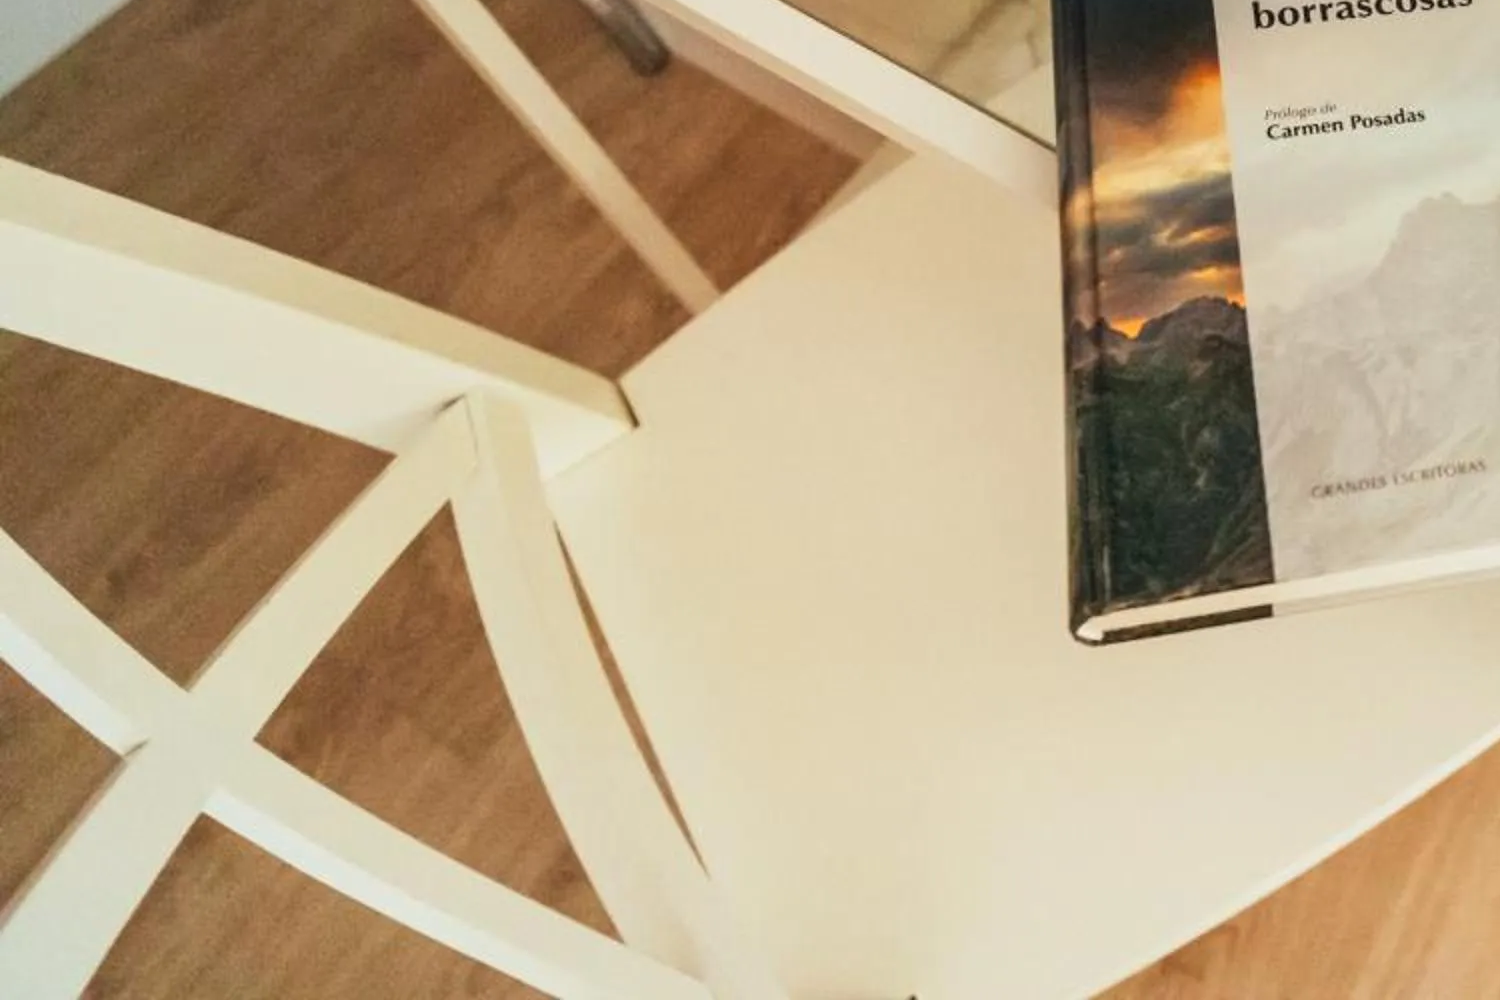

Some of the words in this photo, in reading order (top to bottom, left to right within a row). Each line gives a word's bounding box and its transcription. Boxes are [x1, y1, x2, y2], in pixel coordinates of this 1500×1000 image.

[1267, 116, 1344, 140] Carmen
[1350, 107, 1426, 131] Posadas
[1320, 102, 1337, 114] de
[1311, 474, 1388, 498] GRANDES
[1392, 459, 1487, 485] ESCRITORAS
